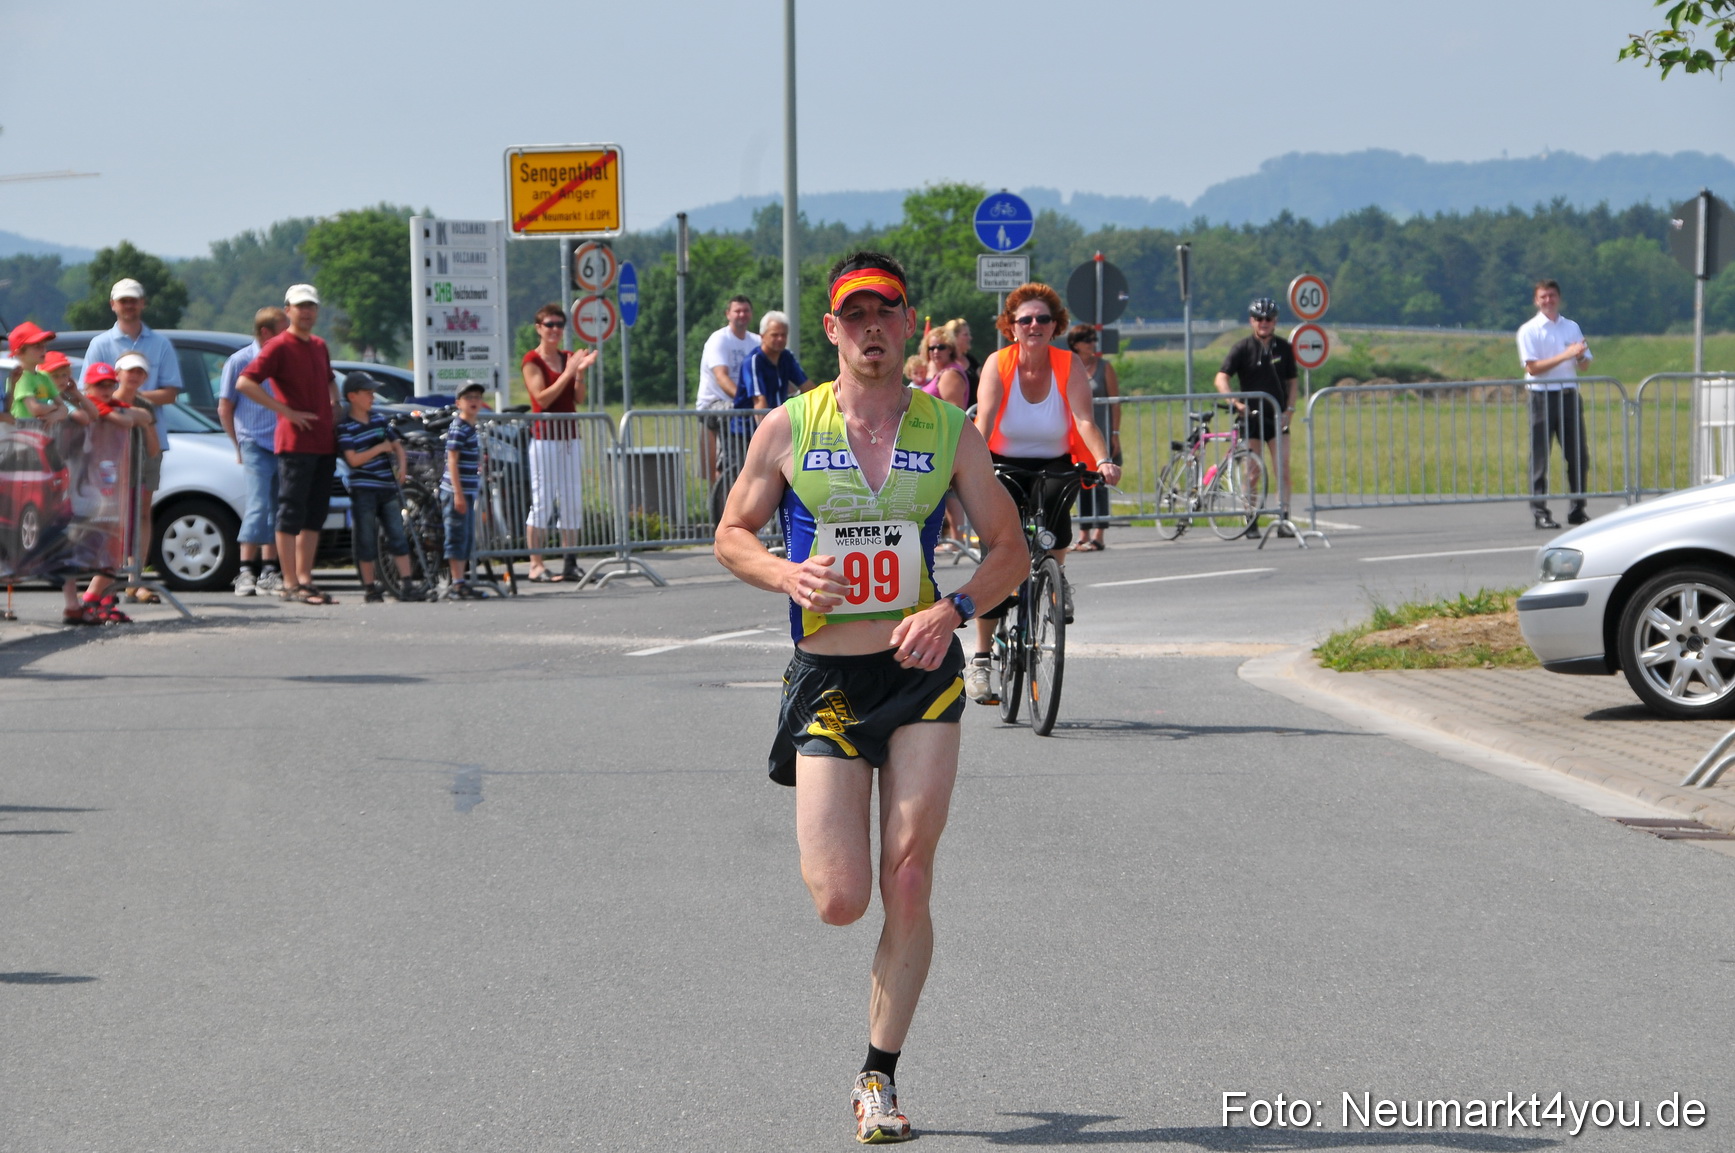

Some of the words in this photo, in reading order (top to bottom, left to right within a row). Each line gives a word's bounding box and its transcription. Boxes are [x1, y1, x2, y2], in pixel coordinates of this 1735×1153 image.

[520, 161, 608, 187] Sengenthal
[532, 190, 551, 200] am
[558, 189, 596, 202] Anger
[543, 211, 580, 221] Neumarkt
[1300, 288, 1320, 307] 60
[835, 526, 881, 538] MEYER
[835, 537, 882, 546] WERBUNG
[843, 550, 899, 605] 99
